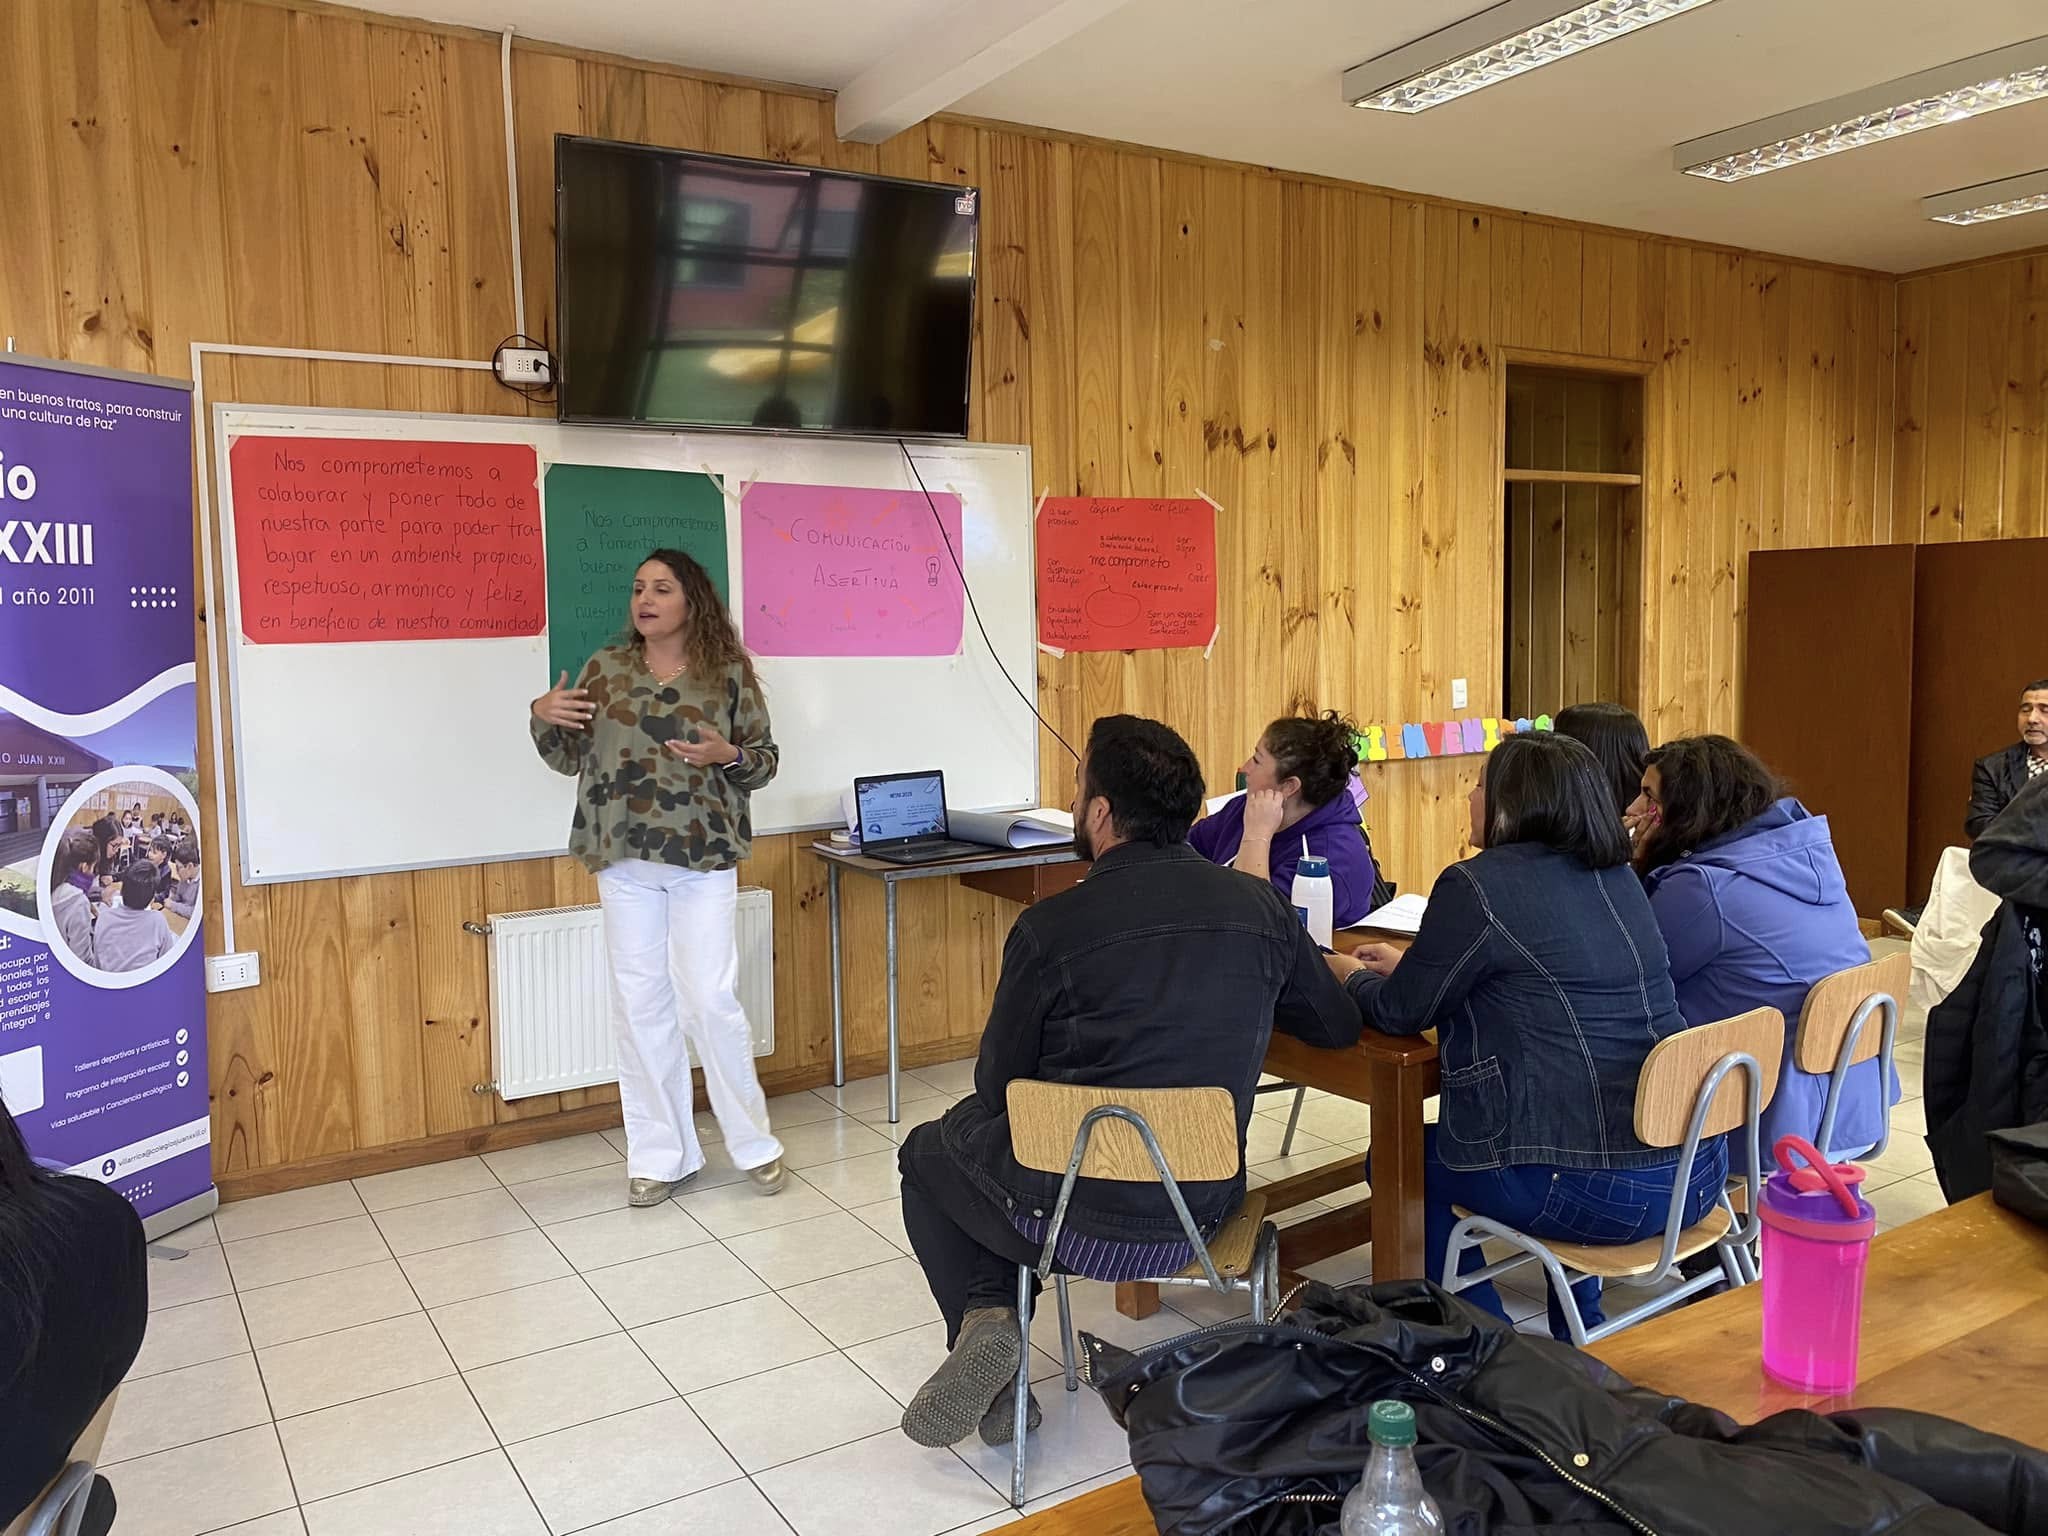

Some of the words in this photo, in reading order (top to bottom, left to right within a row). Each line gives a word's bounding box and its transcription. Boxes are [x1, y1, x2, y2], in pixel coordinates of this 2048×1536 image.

[18, 389, 64, 407] buenos
[66, 396, 103, 413] tratos,
[106, 403, 133, 417] para
[135, 406, 182, 422] construir
[2, 408, 26, 419] una
[29, 410, 72, 425] cultura
[76, 415, 91, 427] de
[274, 451, 305, 473] Nos
[321, 454, 473, 485] comprometemos
[488, 466, 502, 482] a
[258, 484, 348, 504] colaborar
[363, 491, 372, 513] y
[389, 492, 442, 518] poner
[456, 485, 497, 509] todo
[505, 491, 525, 511] de
[260, 510, 330, 533] nuestra
[339, 511, 388, 540] parte
[400, 519, 443, 545] para
[453, 517, 499, 542] poder
[264, 534, 316, 574] bajar
[330, 549, 352, 563] en
[359, 548, 379, 563] un
[391, 544, 463, 565] ambiente
[576, 536, 588, 551] a
[1108, 555, 1170, 574] comprometo
[12, 587, 50, 605] año
[57, 587, 95, 605] 2011
[263, 573, 366, 605] respetuoso,
[465, 587, 473, 609] y
[259, 615, 281, 630] en
[290, 609, 360, 635] beneficio
[368, 610, 387, 630] de
[396, 614, 449, 631] nuestra
[459, 612, 539, 632] comunidad
[18, 753, 43, 765] JUAN
[33, 952, 48, 965] por
[36, 964, 49, 974] las
[6, 981, 32, 993] todos
[36, 976, 49, 986] los
[8, 990, 40, 1005] escolar
[44, 988, 49, 998] y
[1, 1015, 36, 1032] integral
[74, 1059, 100, 1073] Talleres
[101, 1048, 135, 1066] deportivos
[65, 1083, 100, 1100] Programa
[100, 1079, 110, 1089] de
[111, 1068, 147, 1086] integración
[147, 1060, 171, 1074] escolar
[50, 1117, 67, 1129] Vida
[67, 1107, 100, 1124] saludable
[100, 1105, 106, 1115] y
[106, 1093, 142, 1111] Conciencia
